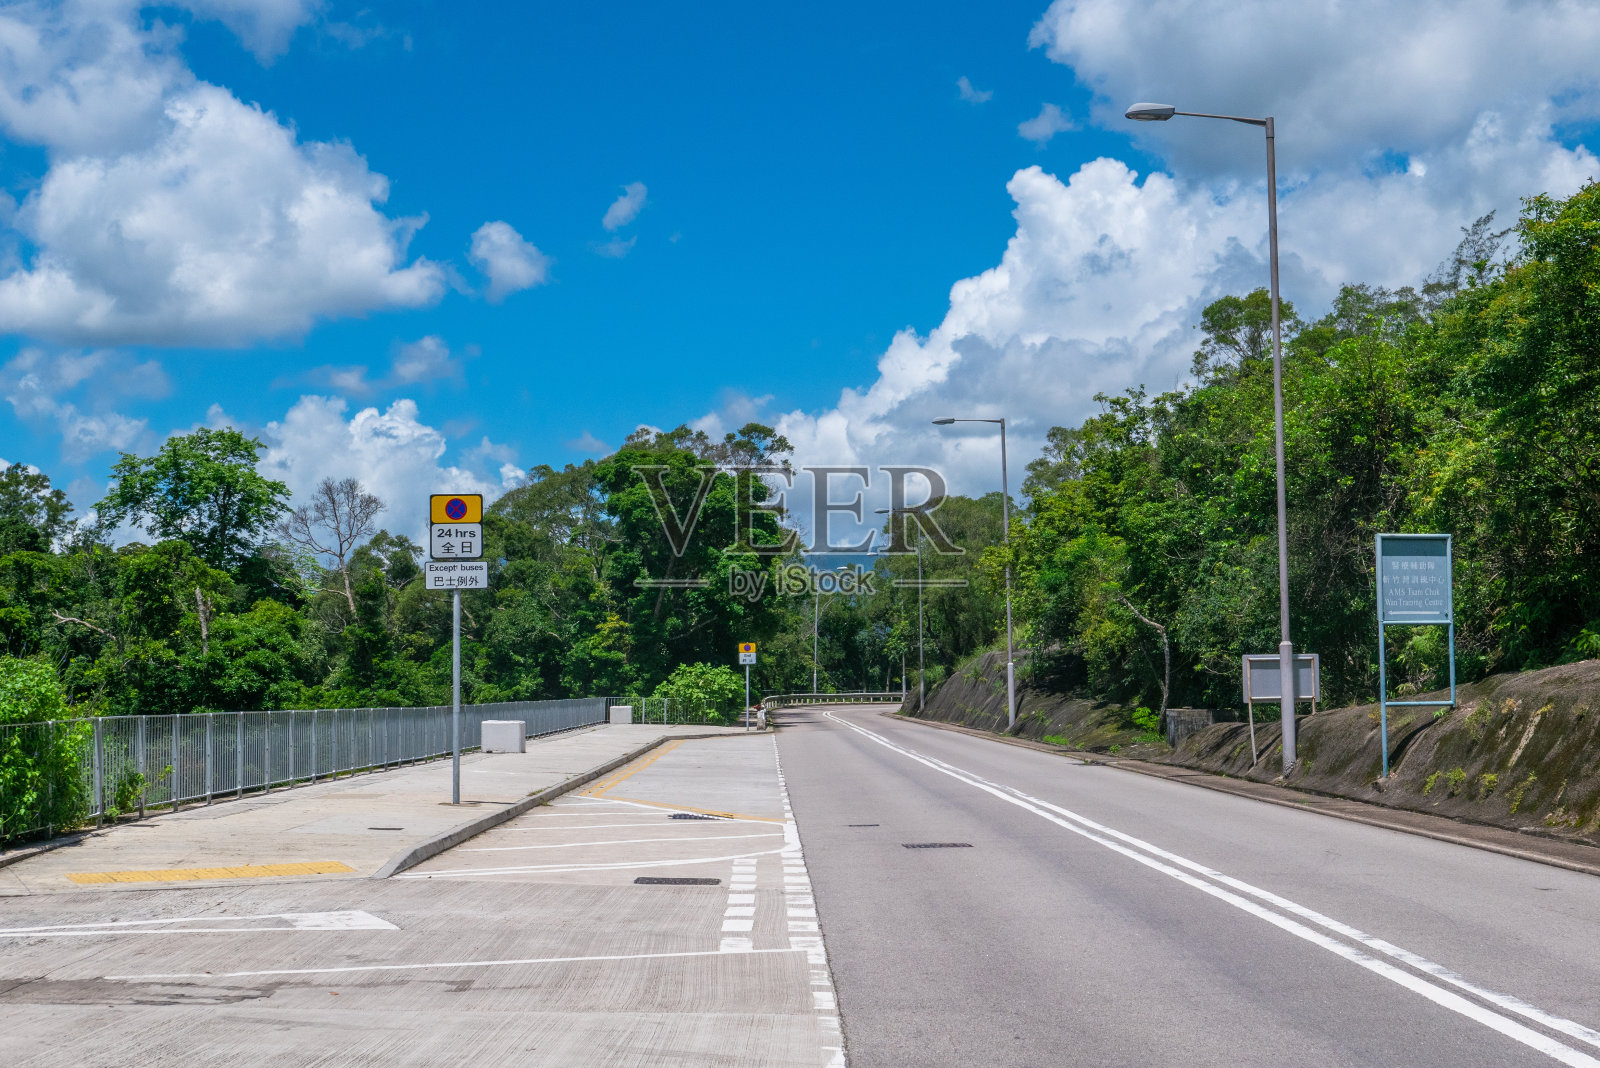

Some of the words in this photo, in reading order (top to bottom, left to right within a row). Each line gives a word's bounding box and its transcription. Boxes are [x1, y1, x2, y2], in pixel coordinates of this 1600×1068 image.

[437, 528, 452, 538] 24
[455, 528, 476, 538] hrs
[442, 542, 472, 554] 全日
[429, 564, 457, 572] Except
[434, 575, 480, 587] 巴士例外
[1389, 588, 1405, 596] AMS
